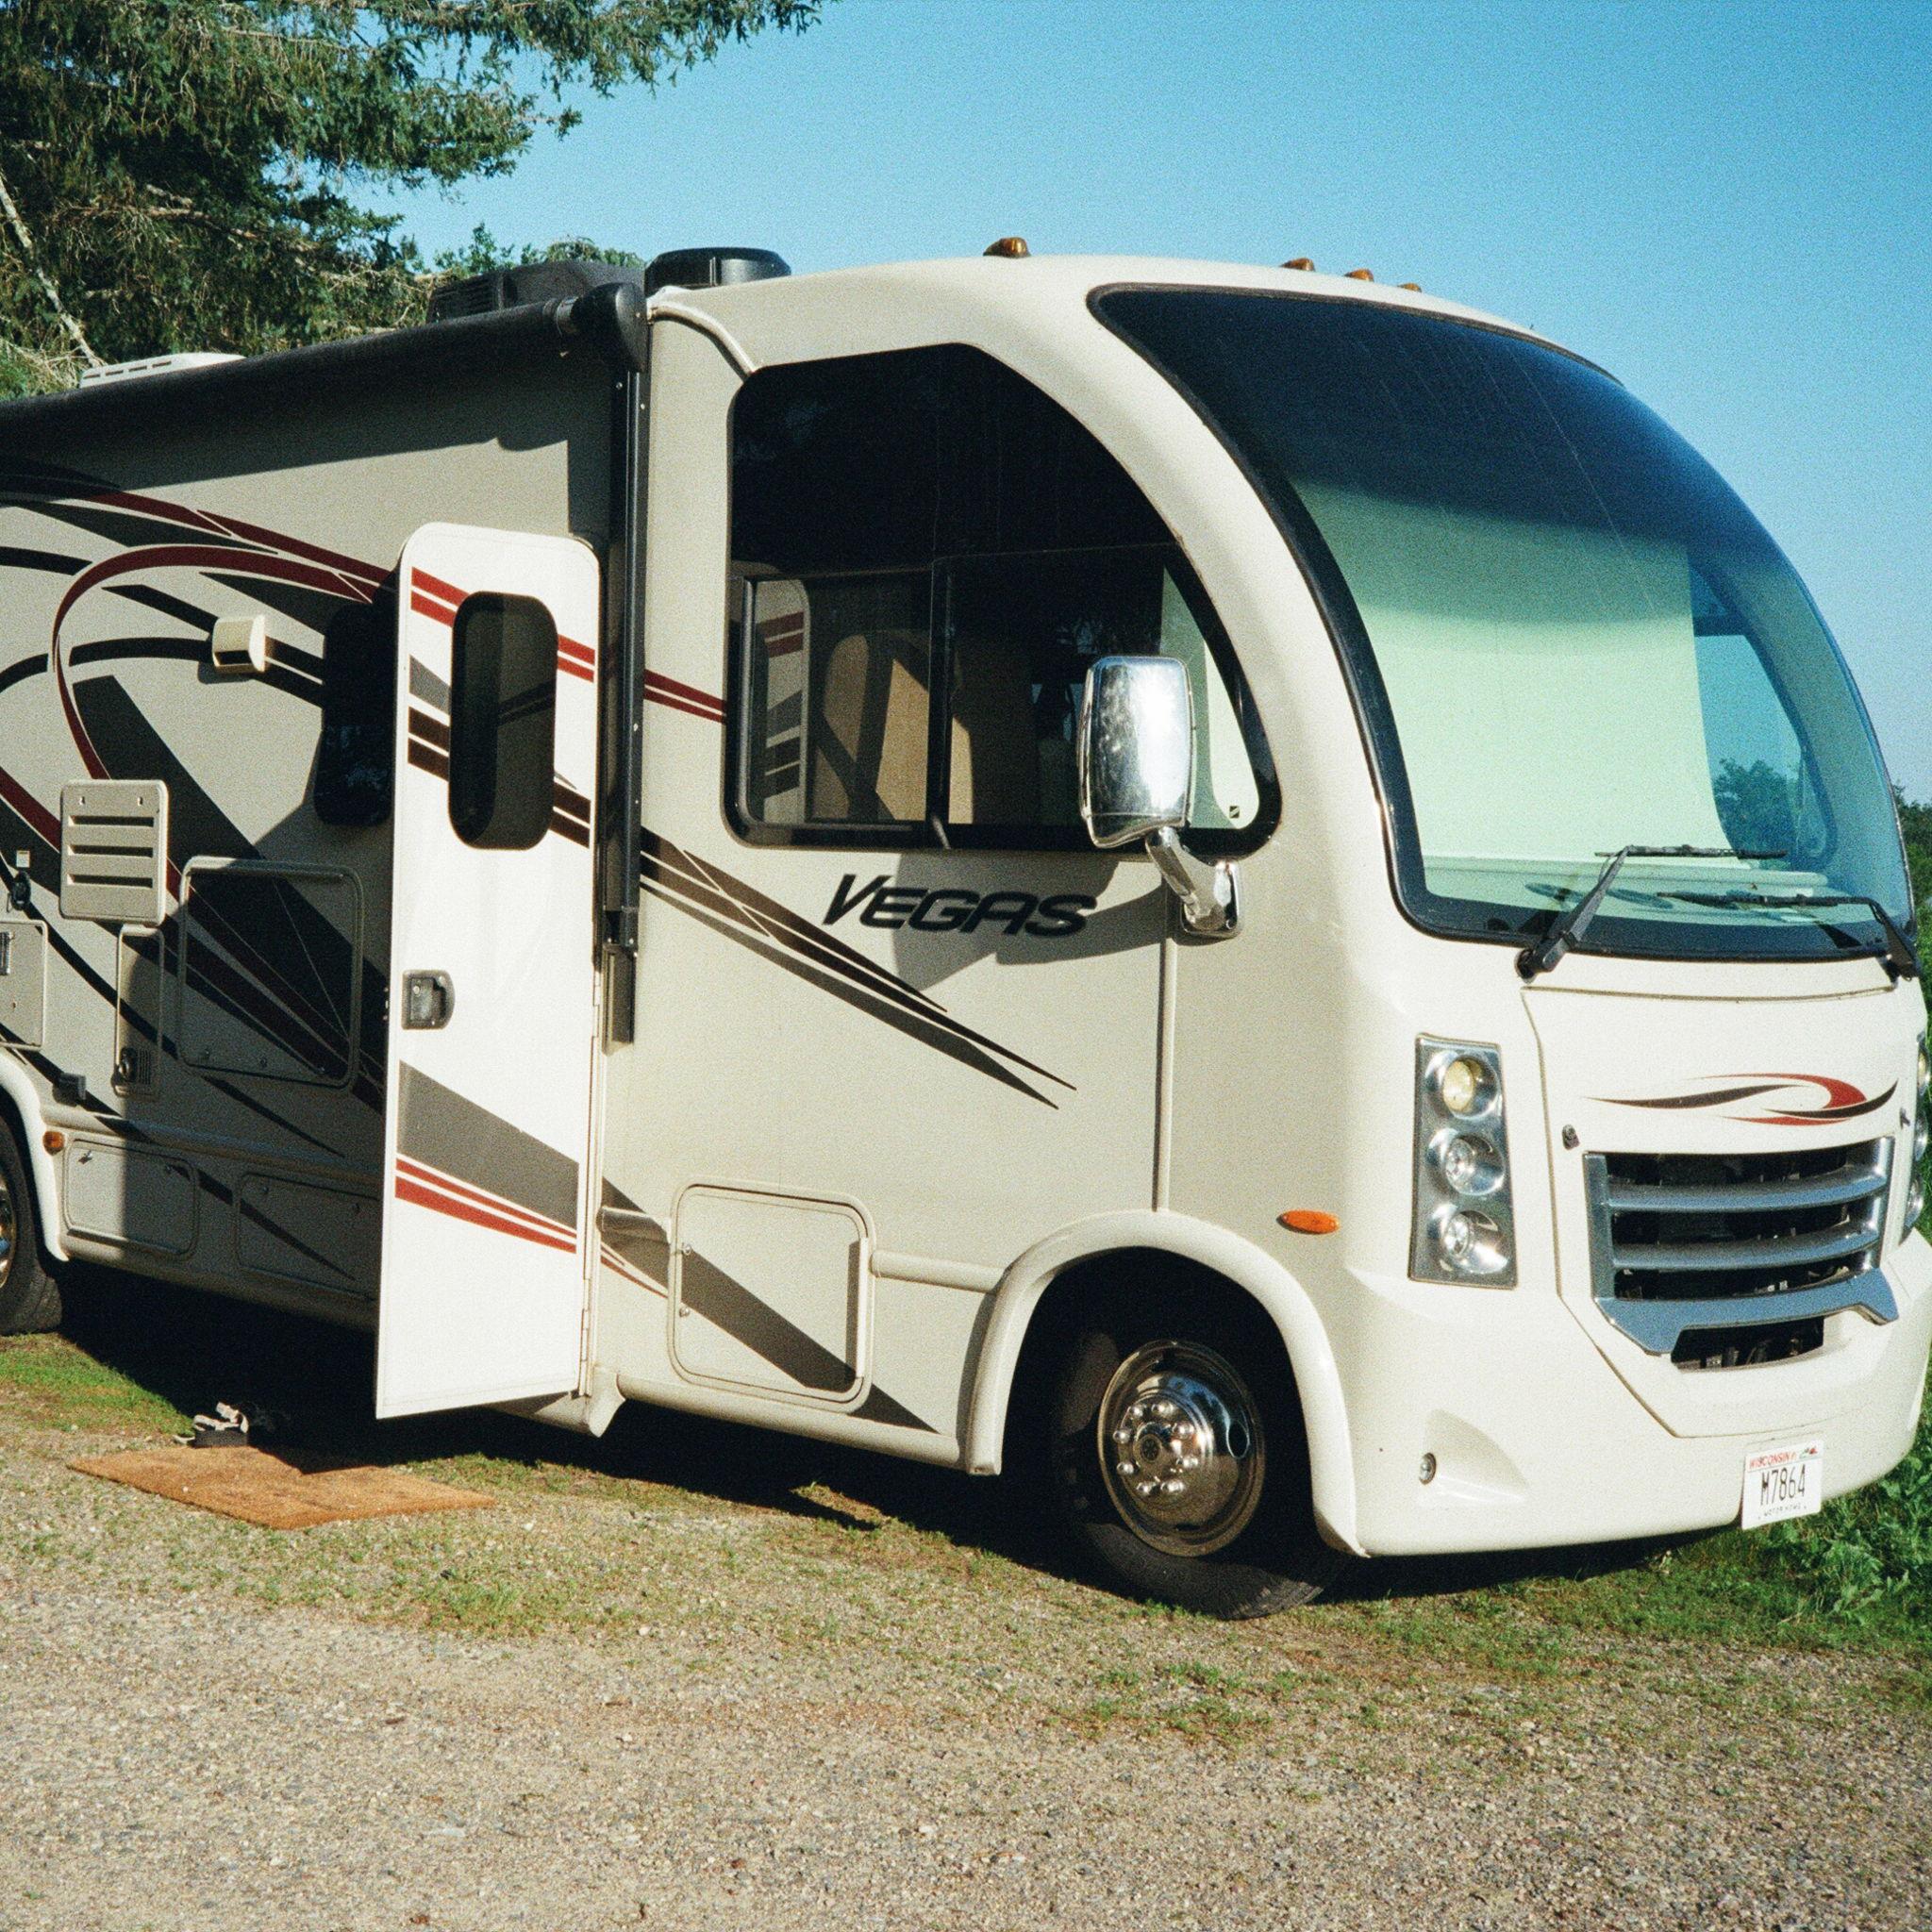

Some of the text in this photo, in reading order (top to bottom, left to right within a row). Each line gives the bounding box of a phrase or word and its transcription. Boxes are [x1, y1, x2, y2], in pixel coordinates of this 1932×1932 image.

[822, 874, 1098, 937] VEGAS
[1749, 1452, 1790, 1469] WISCONSIN
[1760, 1463, 1806, 1506] M7864
